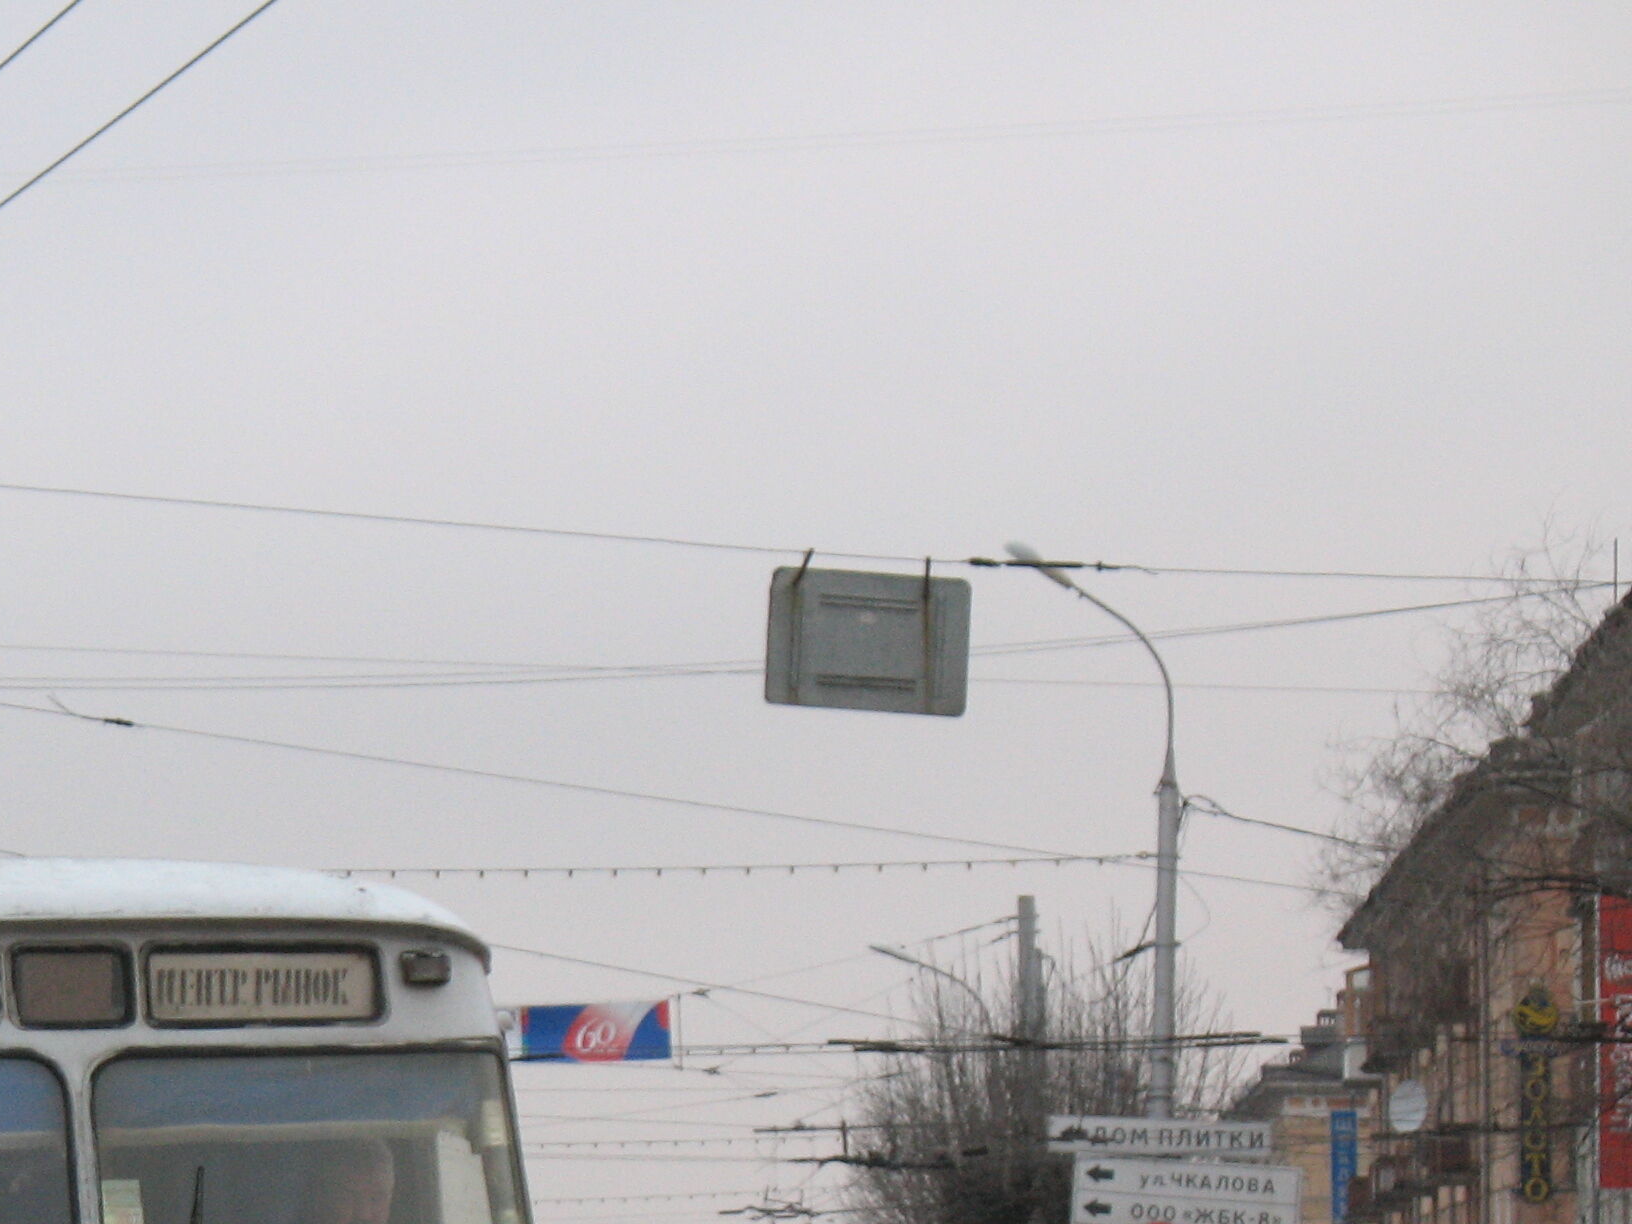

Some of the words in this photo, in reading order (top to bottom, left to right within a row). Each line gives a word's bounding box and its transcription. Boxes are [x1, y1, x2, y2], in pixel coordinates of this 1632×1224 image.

[254, 967, 349, 1006] РЫНОК
[576, 1015, 618, 1052] 60
[1092, 1127, 1150, 1146] ДОМ
[1158, 1127, 1265, 1149] ПЛИТКИ
[1130, 1203, 1177, 1222] ООО
